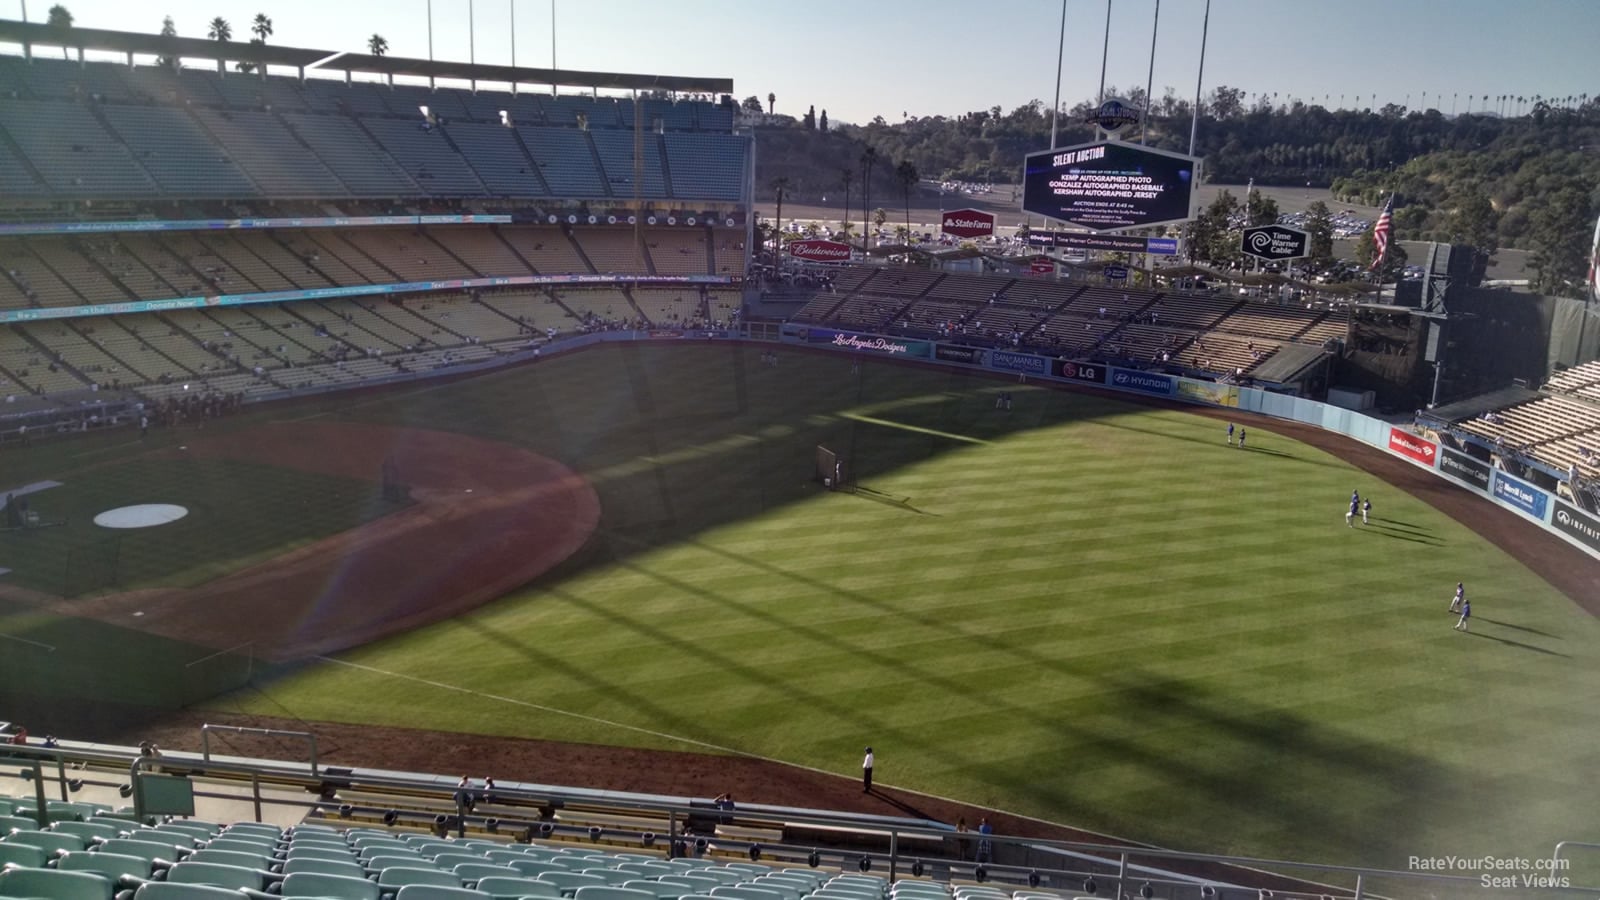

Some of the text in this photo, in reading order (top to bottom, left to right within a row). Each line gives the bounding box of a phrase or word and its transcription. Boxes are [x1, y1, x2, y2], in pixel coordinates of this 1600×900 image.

[1053, 147, 1105, 167] SILENT AUCTION
[792, 244, 849, 256] Budweiser
[875, 338, 907, 354] Dodgers
[993, 353, 1008, 362] SAN
[1013, 356, 1042, 367] MANUEL
[1078, 366, 1095, 379] LG
[1131, 376, 1170, 390] HYUNDAI
